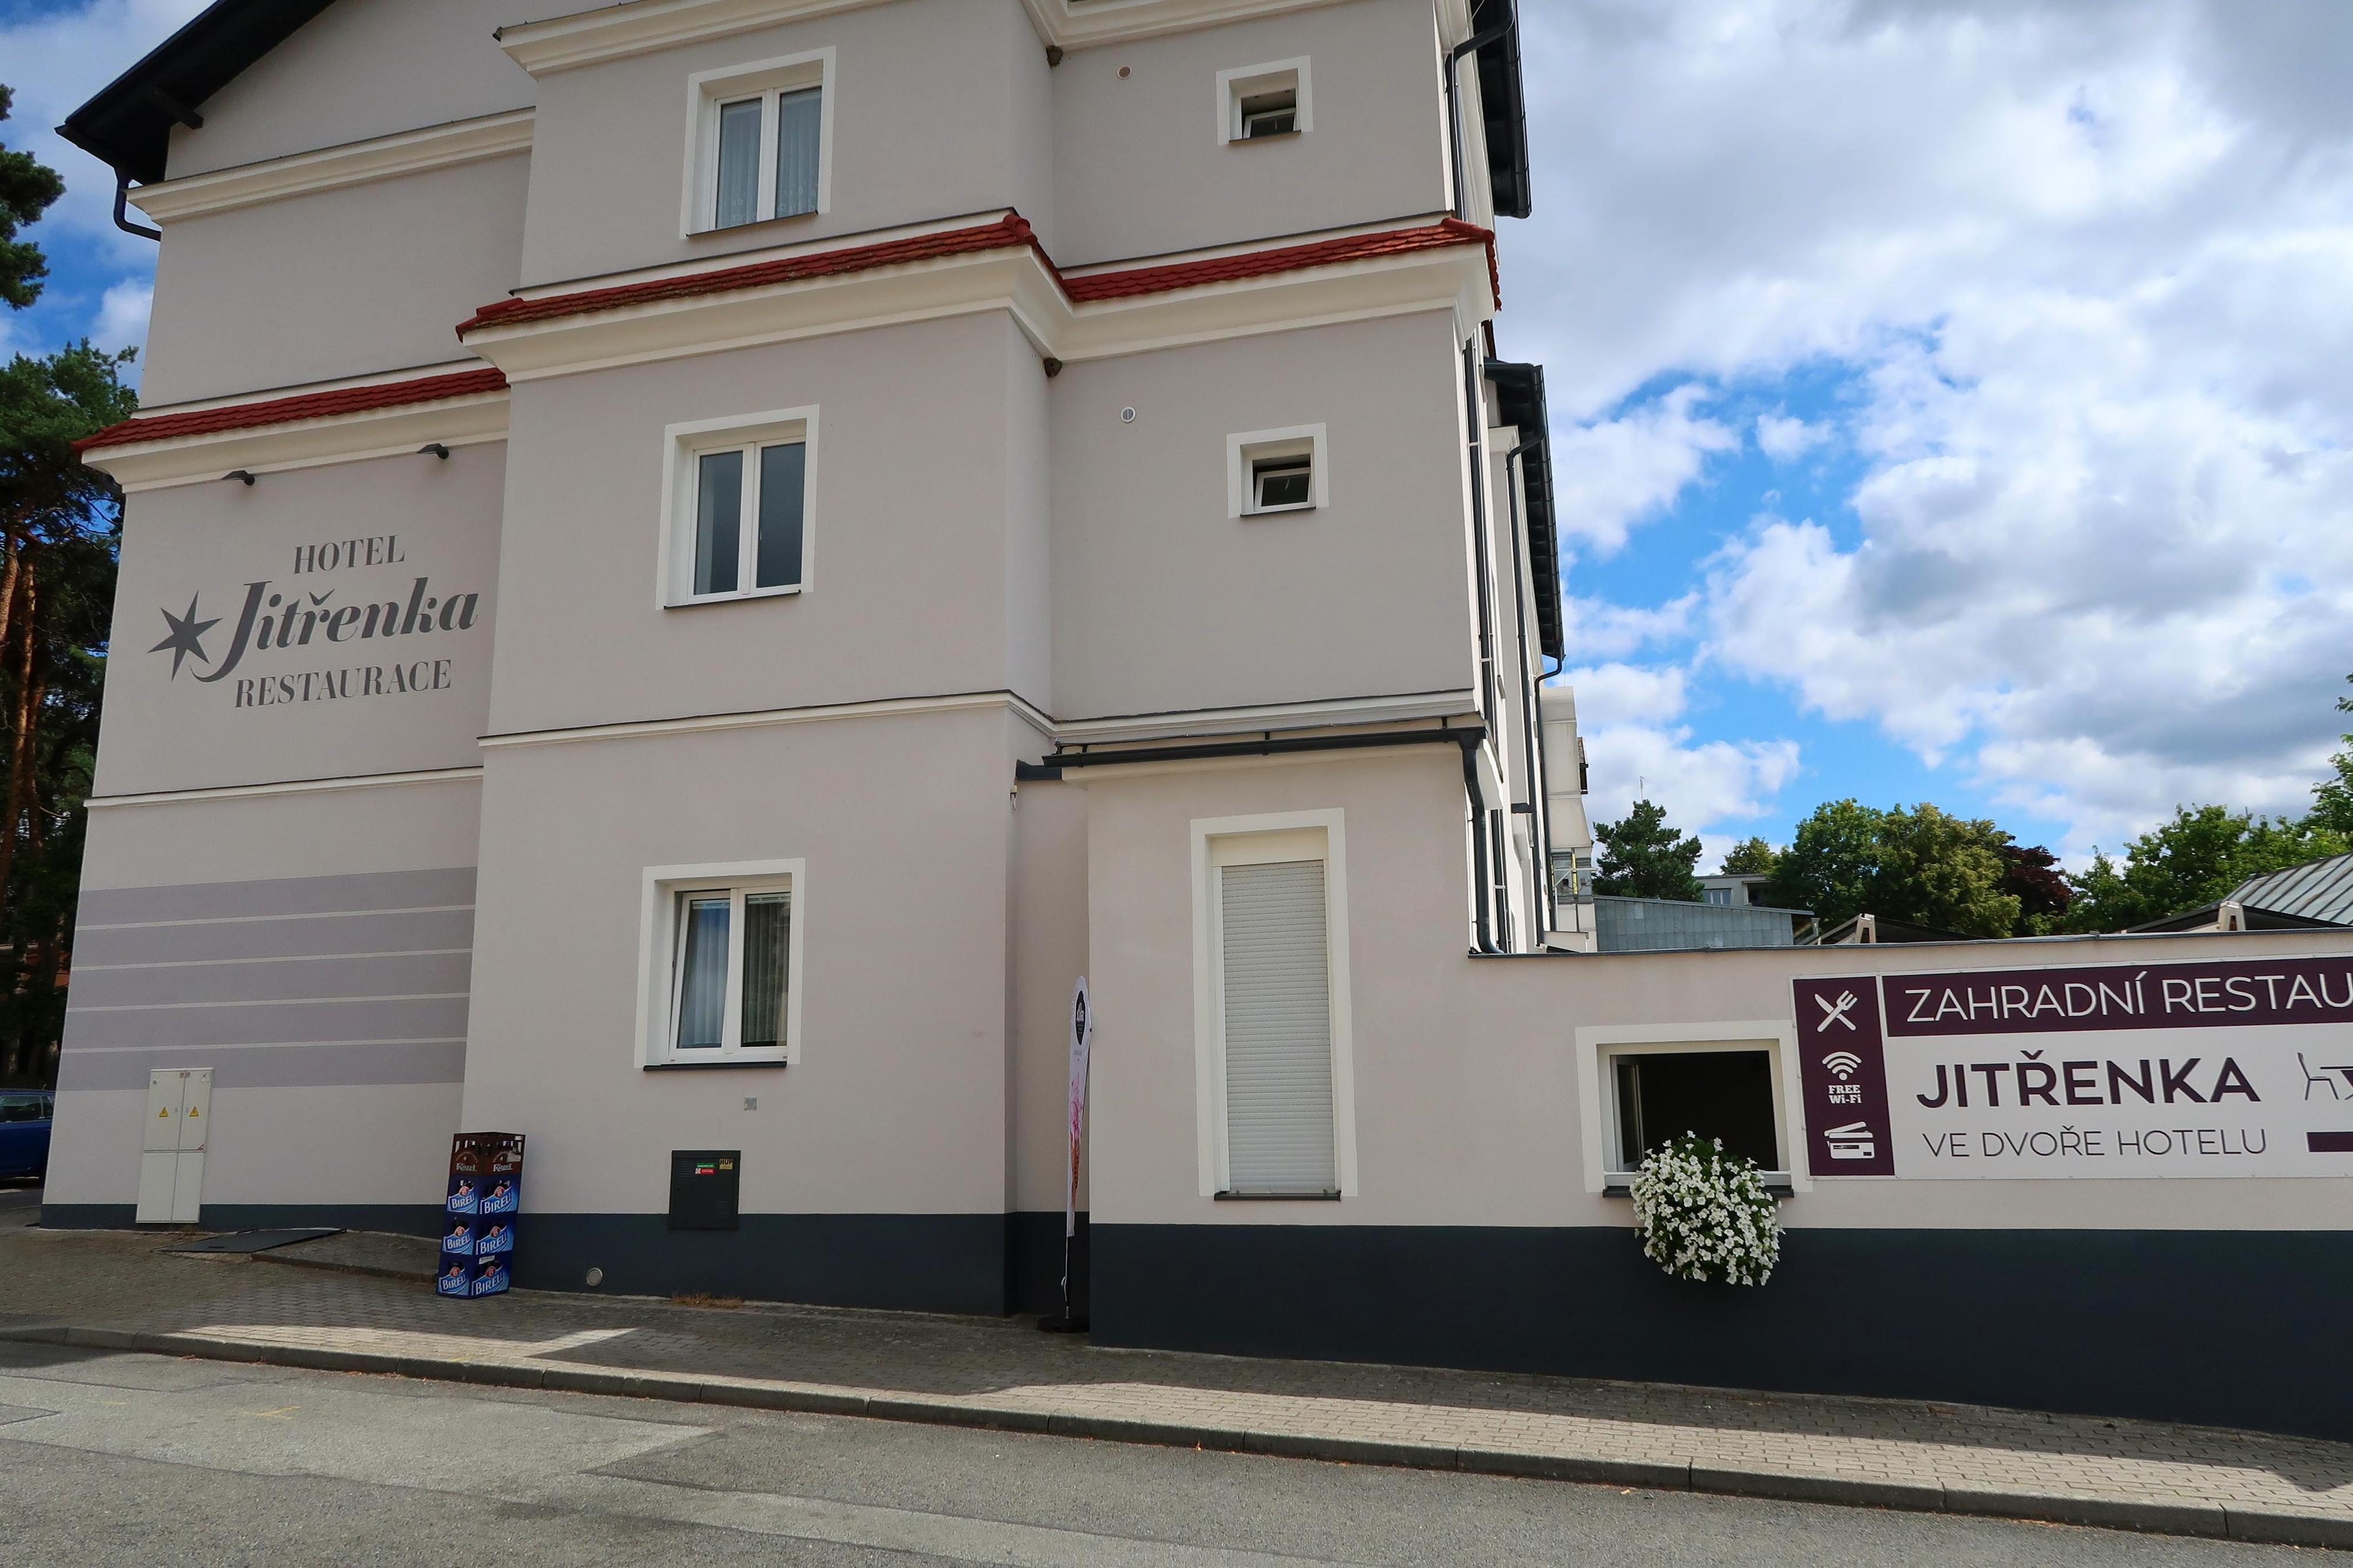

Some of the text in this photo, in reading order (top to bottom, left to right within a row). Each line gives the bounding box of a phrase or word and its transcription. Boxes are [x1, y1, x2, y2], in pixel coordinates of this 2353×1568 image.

[293, 535, 406, 575] HOTEL
[190, 576, 479, 682] Jitřenka
[234, 659, 452, 708] RESTAURACE
[1905, 972, 2148, 1022] ZAHRADNÍ
[1828, 1085, 1861, 1094] FREE
[1916, 1050, 2261, 1108] JITŘENKA
[1829, 1095, 1862, 1104] Wi-Fi
[1922, 1126, 2267, 1157] VE DVOŘE HOTELU
[493, 1163, 513, 1172] Kozel
